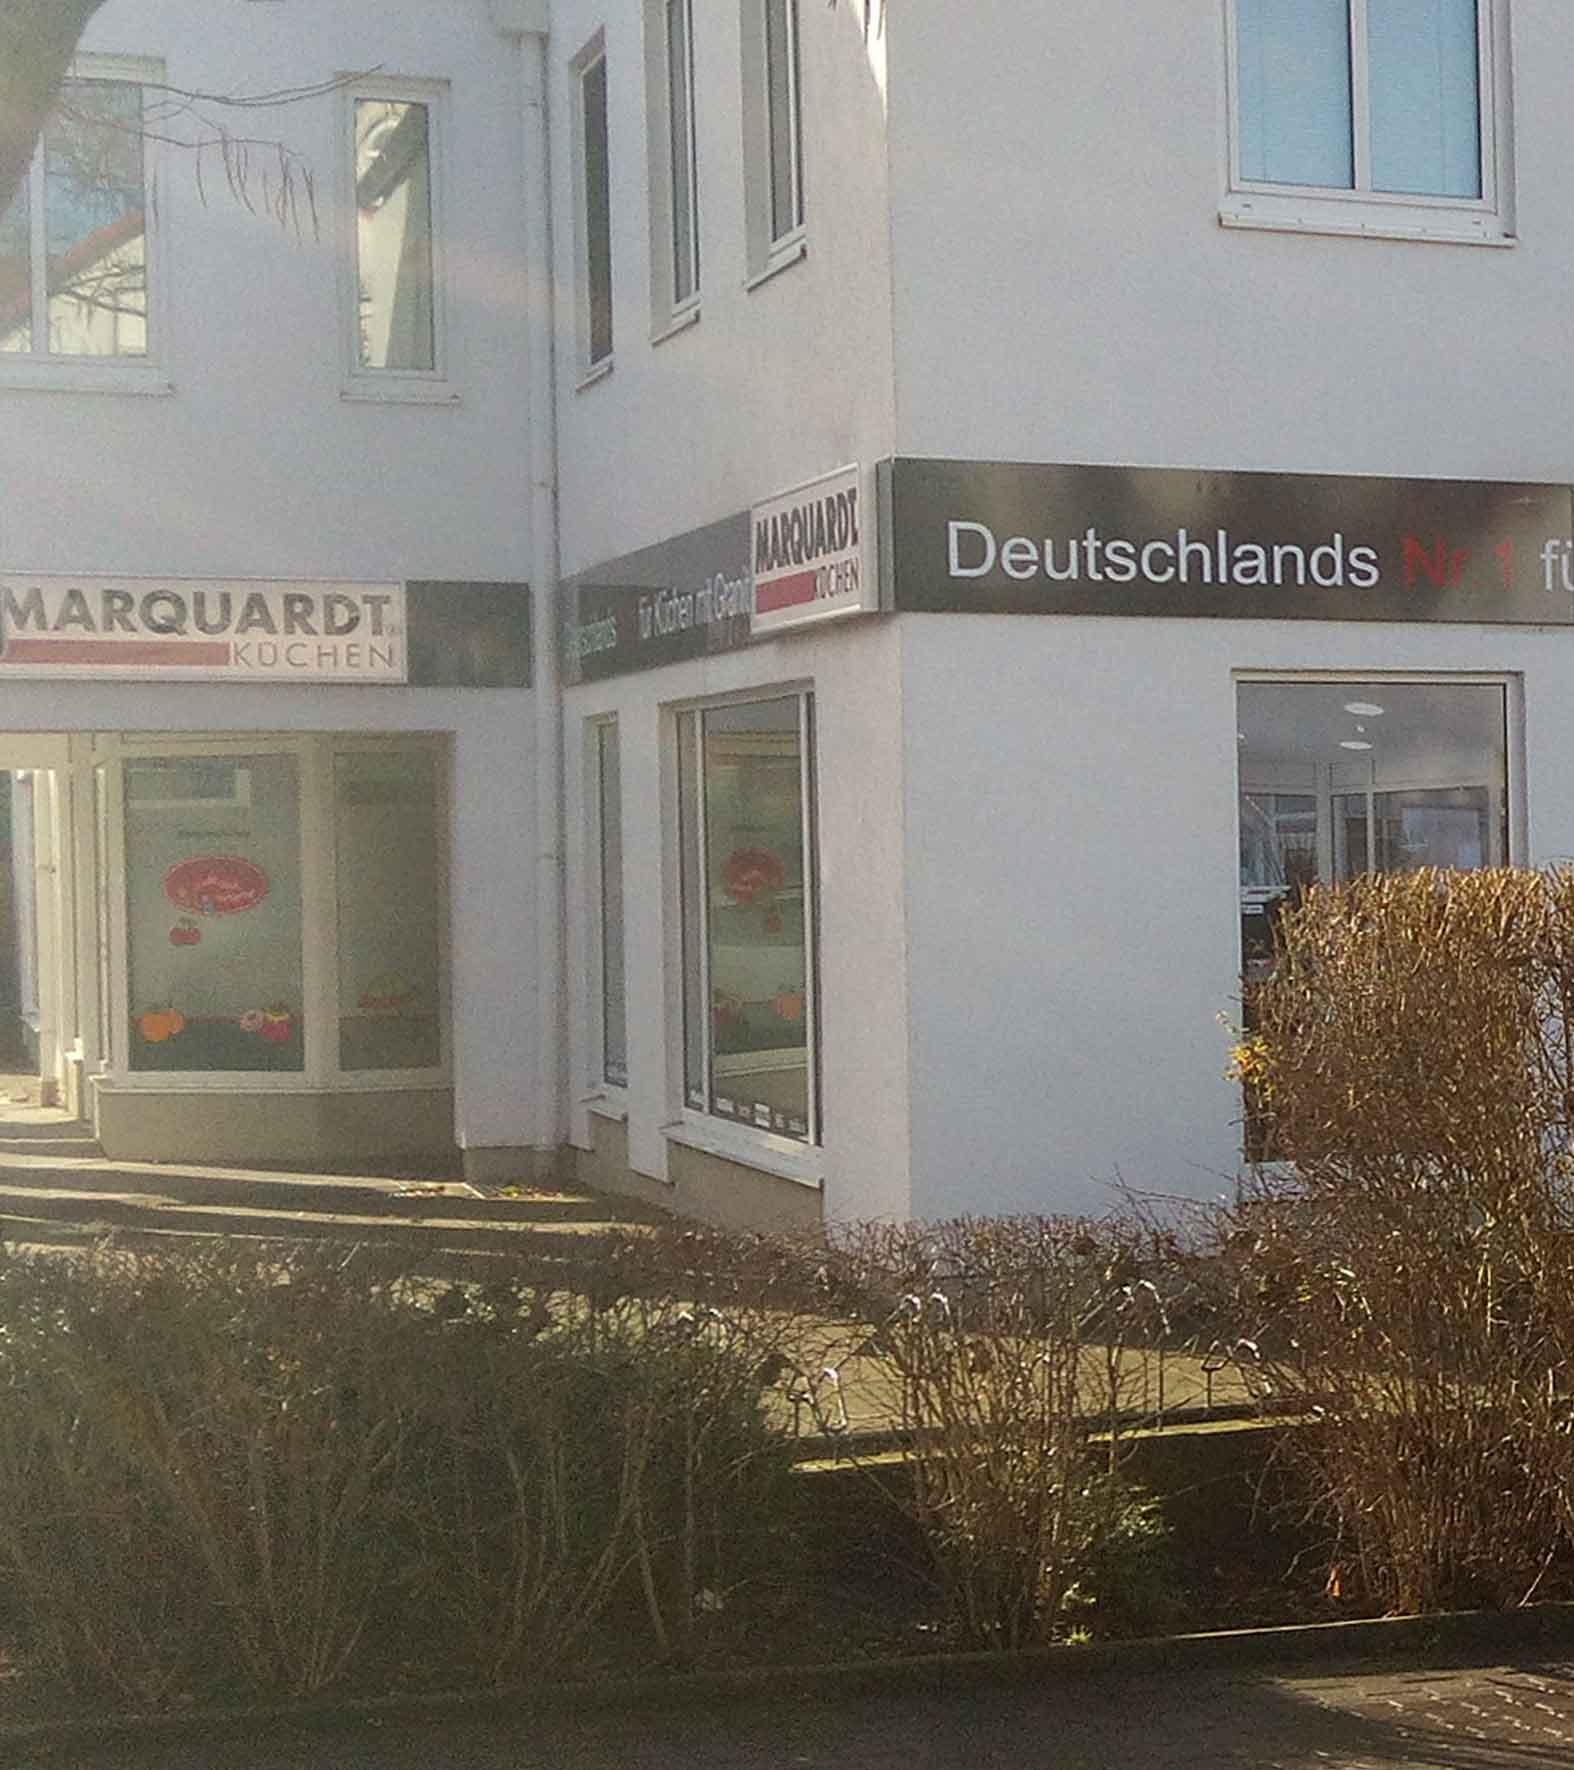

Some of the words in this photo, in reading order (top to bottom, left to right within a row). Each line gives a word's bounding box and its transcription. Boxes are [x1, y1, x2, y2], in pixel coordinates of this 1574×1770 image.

[755, 486, 859, 574] MARQUARDT
[946, 520, 1381, 588] Deutschlands
[1490, 535, 1514, 592] 1
[0, 587, 393, 637] MARQUARDT
[232, 640, 395, 670] KÜCHEN
